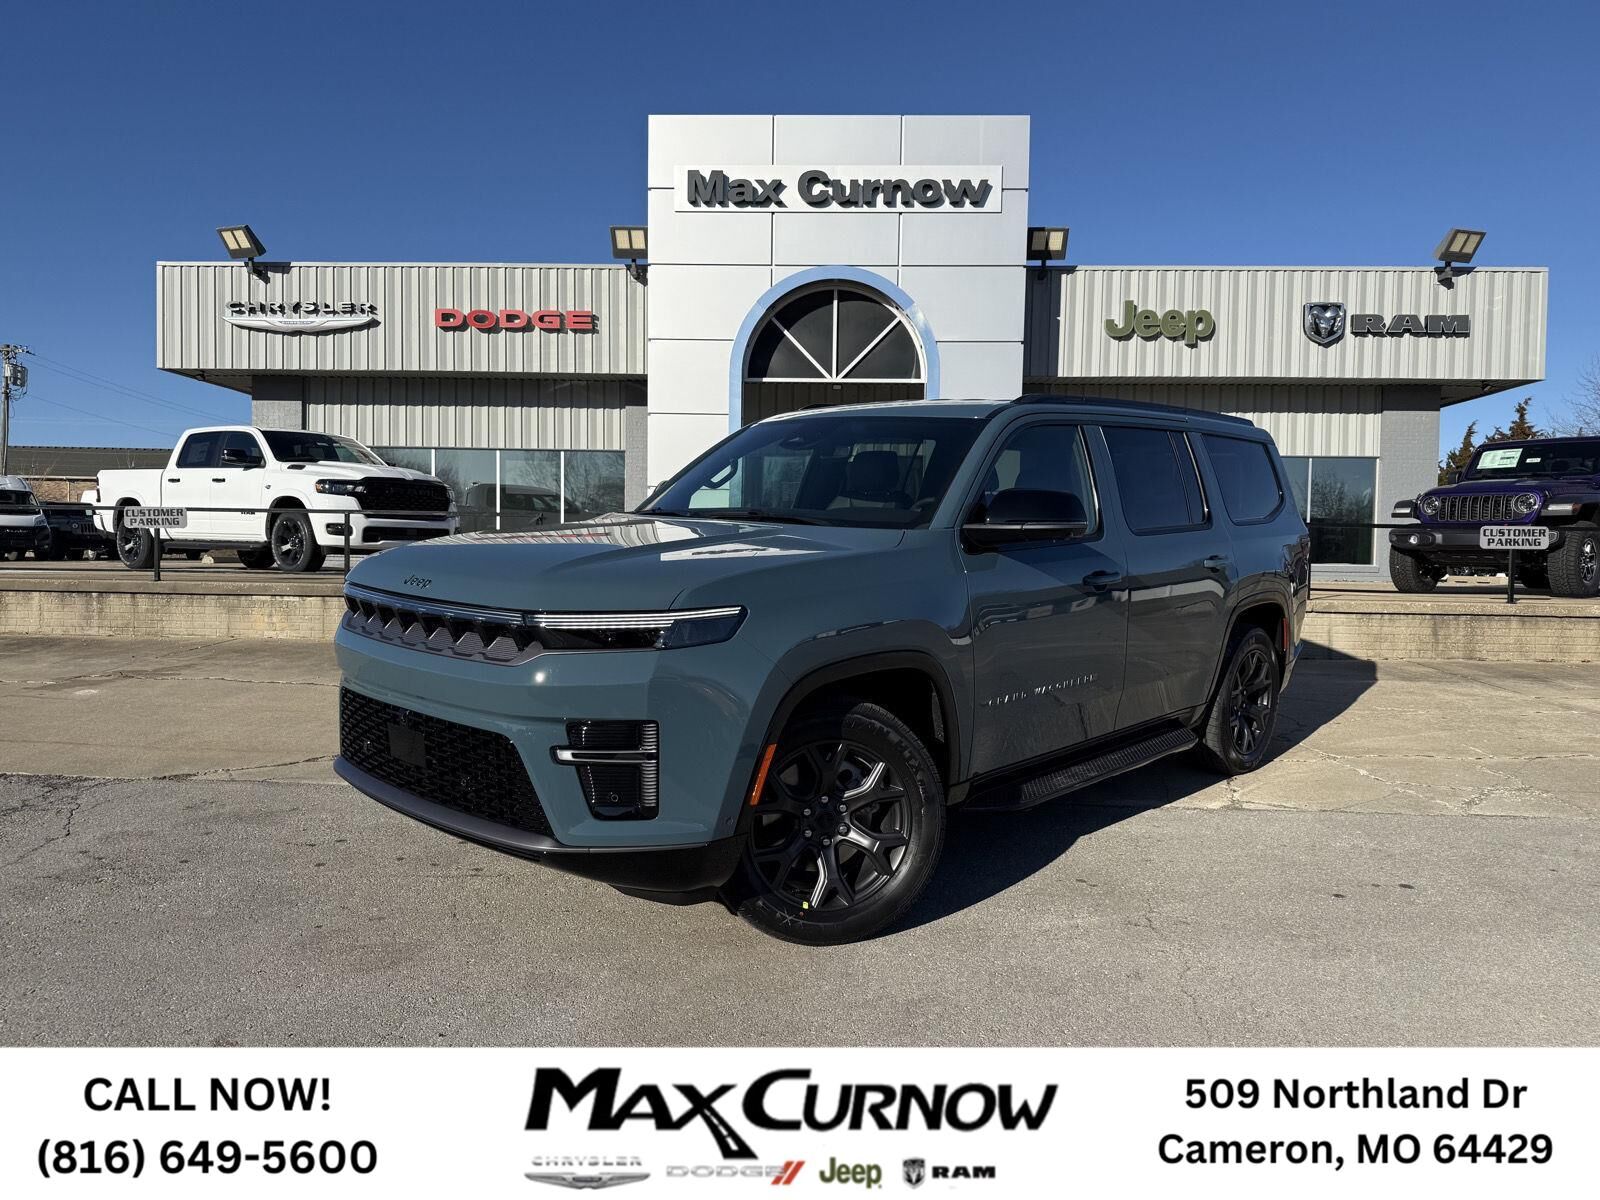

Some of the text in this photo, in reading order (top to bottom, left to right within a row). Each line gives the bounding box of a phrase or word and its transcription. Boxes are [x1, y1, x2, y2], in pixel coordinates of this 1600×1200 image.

[687, 169, 992, 207] Max Curnow
[225, 301, 377, 315] CHRYSLER
[435, 308, 595, 331] DODGE
[1104, 299, 1215, 347] Jeep
[1350, 313, 1471, 337] RAM
[125, 508, 184, 518] CUSTOMER
[129, 517, 180, 526] PARKING
[1482, 528, 1547, 538] CUSTOMER
[1487, 538, 1541, 547] PARKING
[403, 574, 432, 590] Jeep
